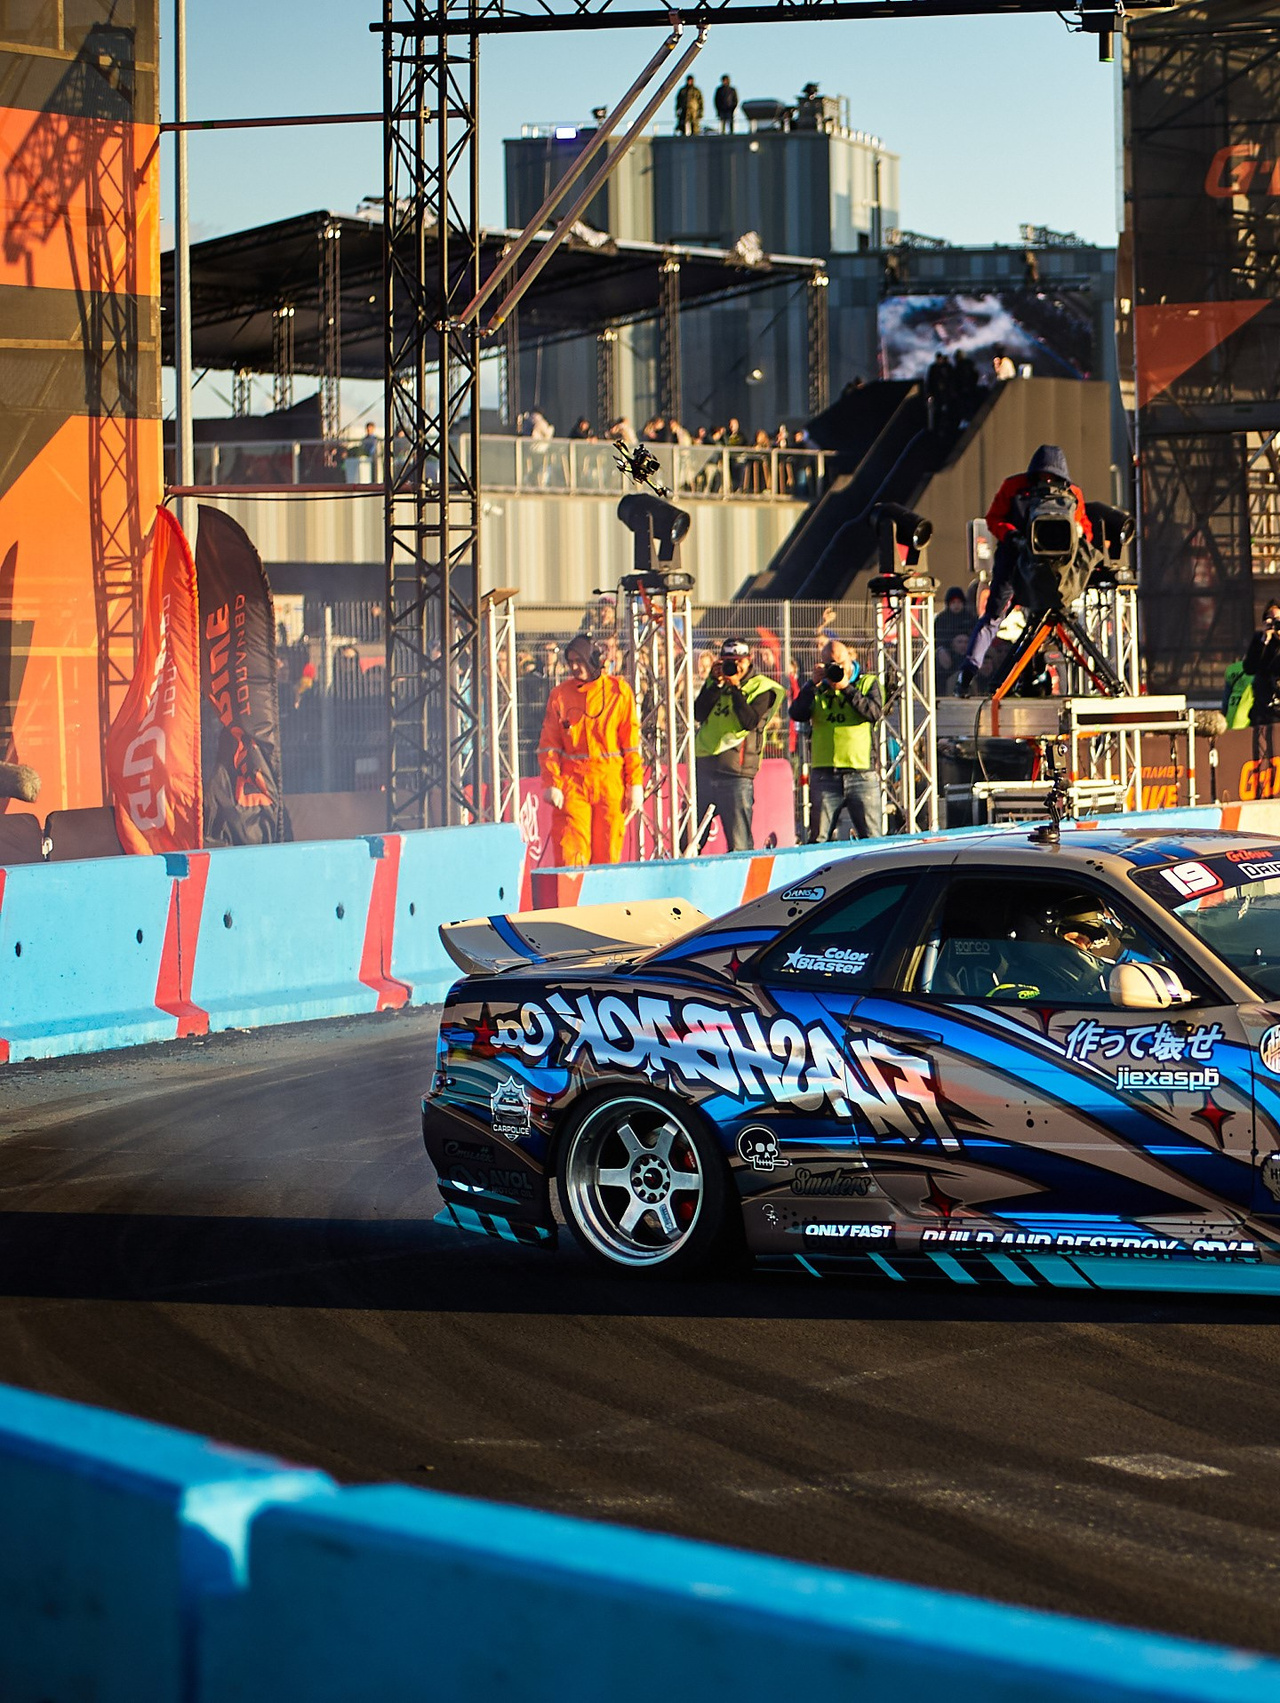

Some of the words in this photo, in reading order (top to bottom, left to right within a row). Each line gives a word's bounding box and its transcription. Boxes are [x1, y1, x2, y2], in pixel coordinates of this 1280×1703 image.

[1159, 861, 1220, 898] 19
[824, 947, 869, 962] Color
[797, 957, 863, 974] Blaster
[492, 1124, 531, 1135] CARPOLICE
[791, 1167, 870, 1197] Smokers
[805, 1224, 852, 1238] ONLY
[850, 1225, 892, 1238] FAST
